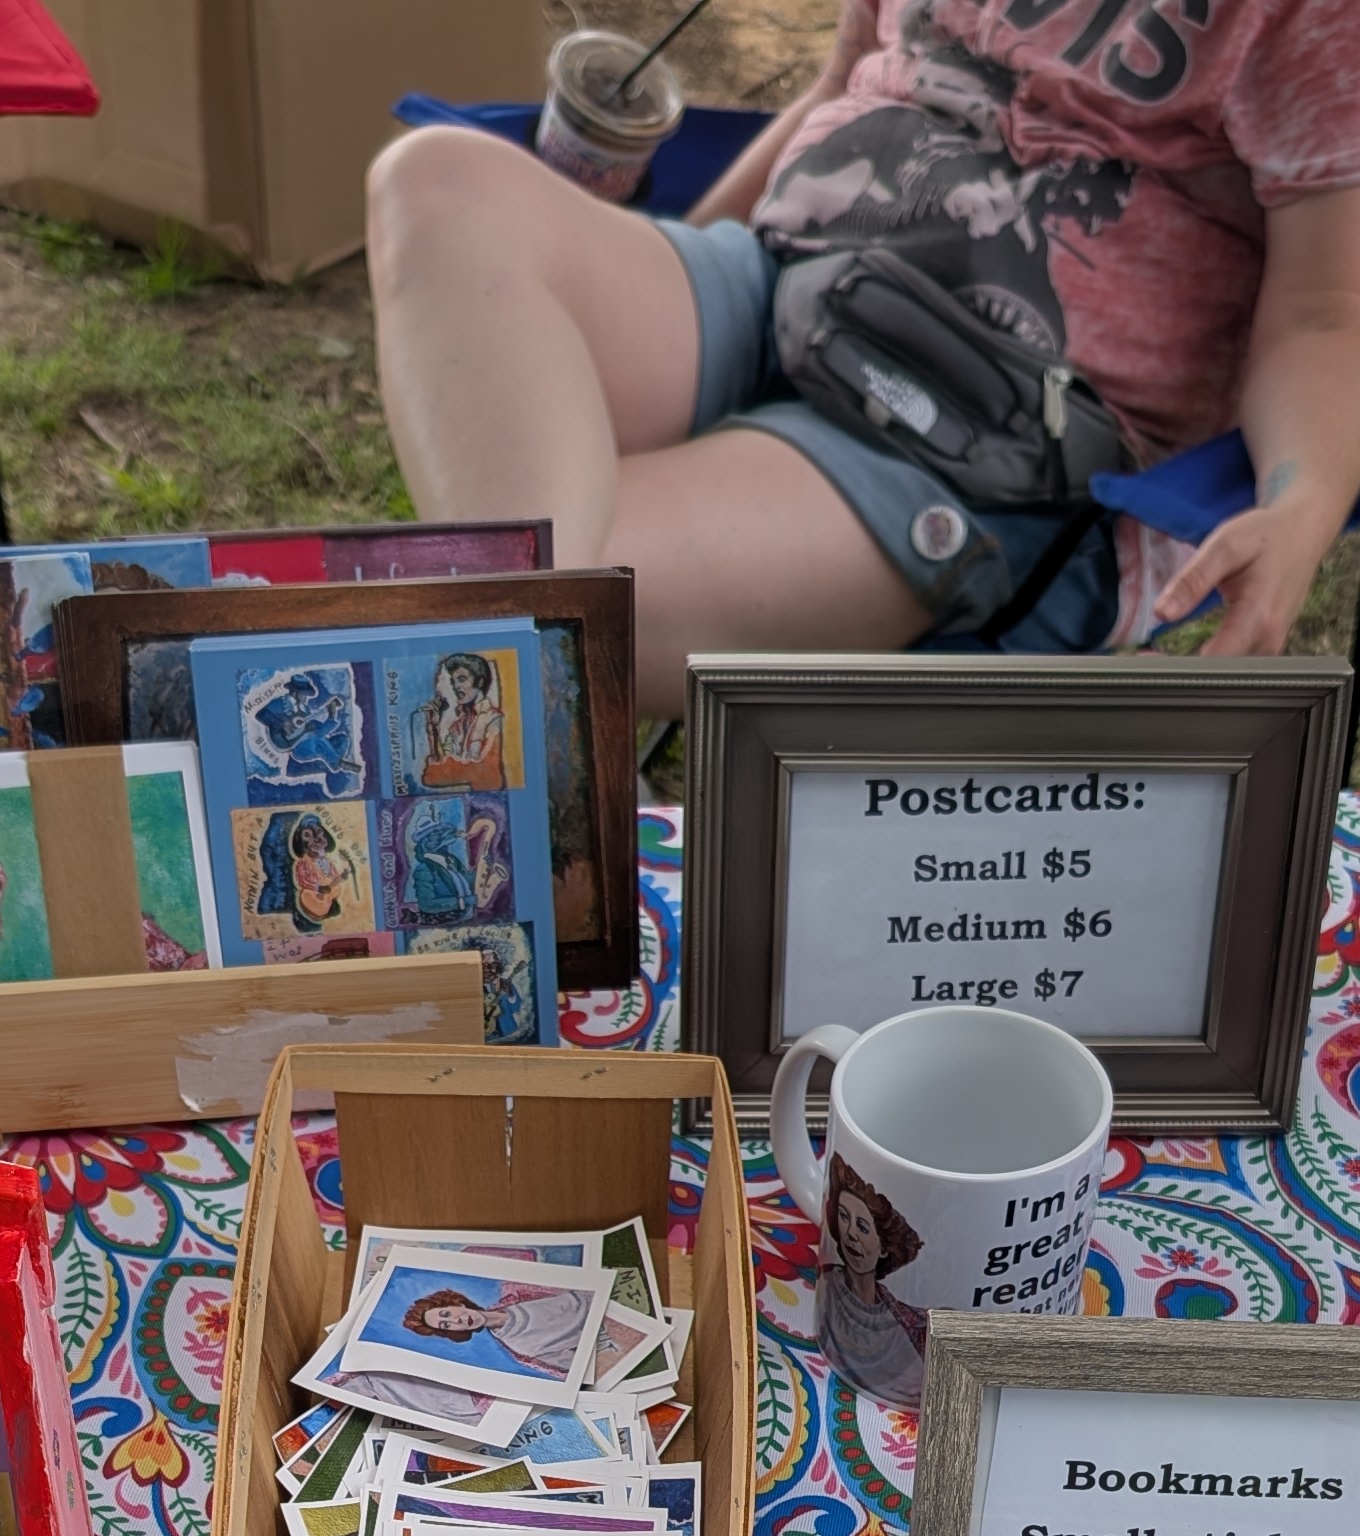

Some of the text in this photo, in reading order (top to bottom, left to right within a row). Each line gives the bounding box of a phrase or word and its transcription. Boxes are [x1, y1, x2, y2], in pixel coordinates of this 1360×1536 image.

[387, 670, 399, 706] KING
[863, 773, 1146, 816] Postcards:
[248, 833, 259, 861] BUT
[913, 846, 1092, 883] Small $5
[885, 906, 1113, 945] Medium $6
[910, 969, 1084, 1007] Large $7
[1004, 1173, 1091, 1228] I'm a
[983, 1211, 1085, 1276] great
[971, 1241, 1086, 1308] reader
[1063, 1460, 1344, 1501] Bookmarks
